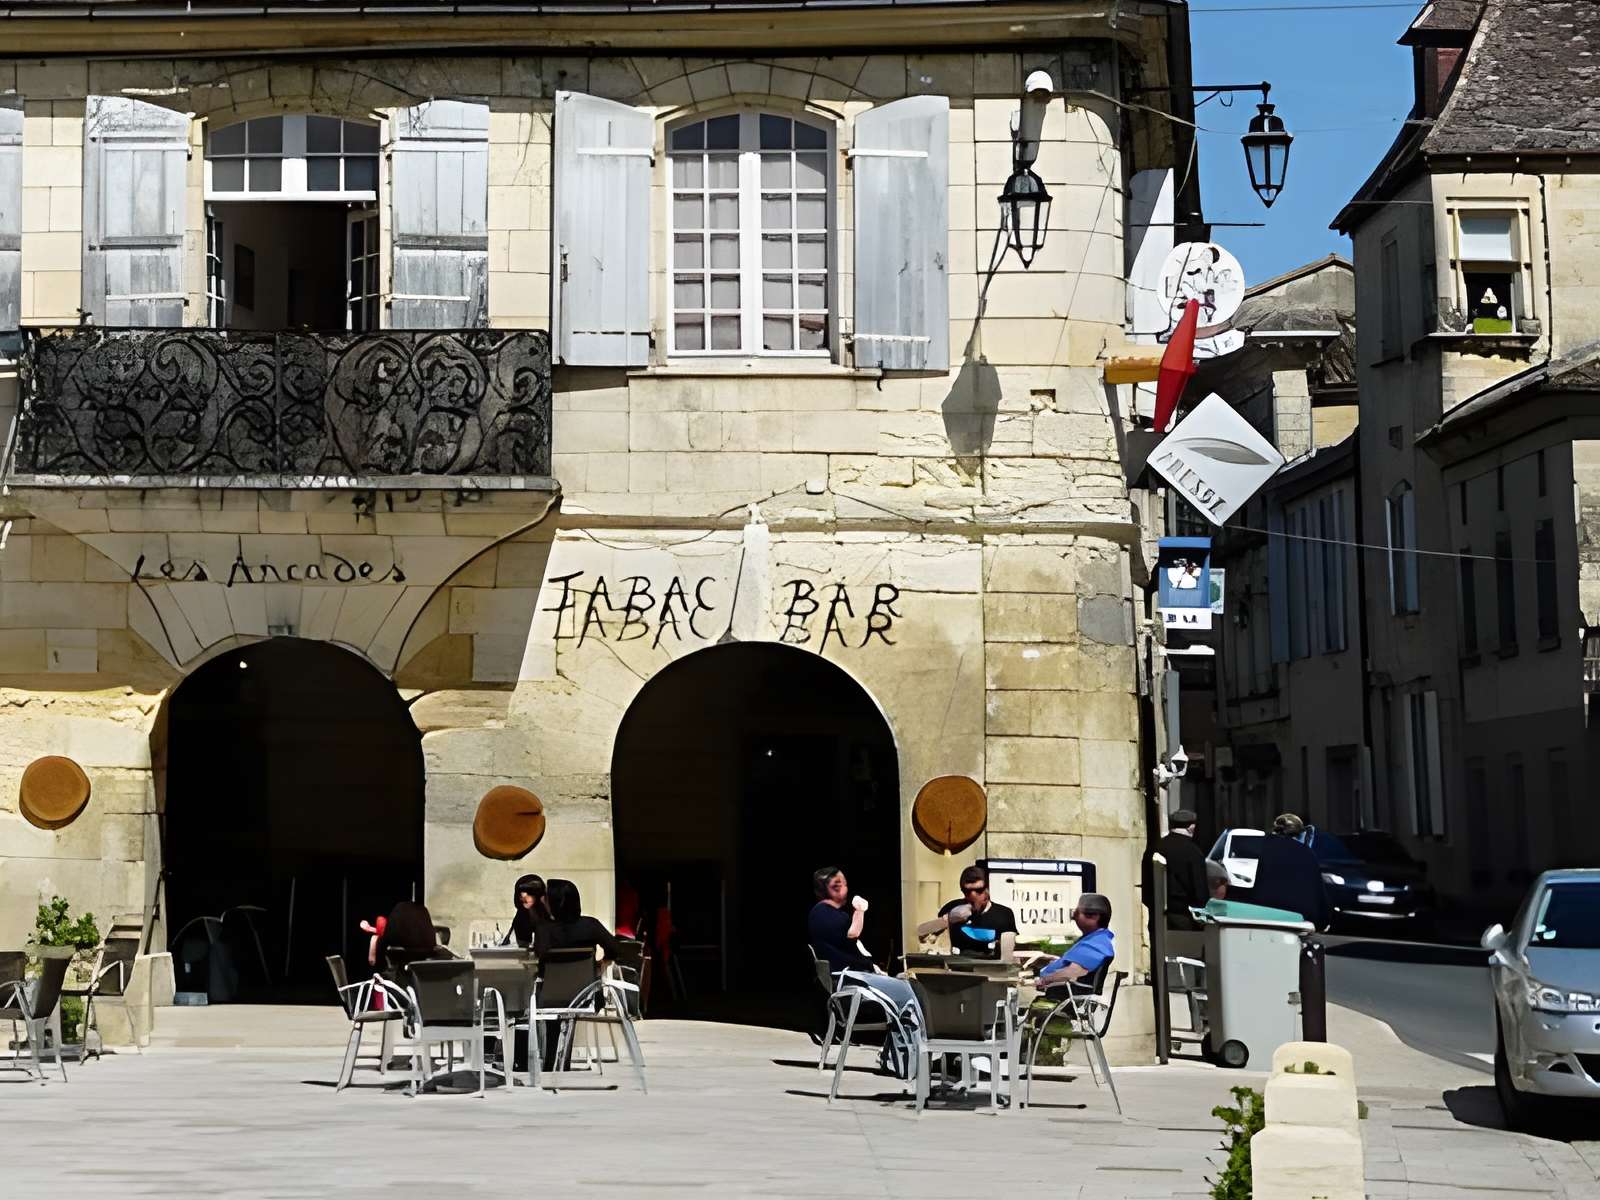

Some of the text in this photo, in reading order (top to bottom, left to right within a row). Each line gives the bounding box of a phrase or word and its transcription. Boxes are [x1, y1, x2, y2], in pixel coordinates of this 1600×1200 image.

[132, 552, 406, 587] Les Arcades
[543, 571, 902, 652] TABAC BAR
